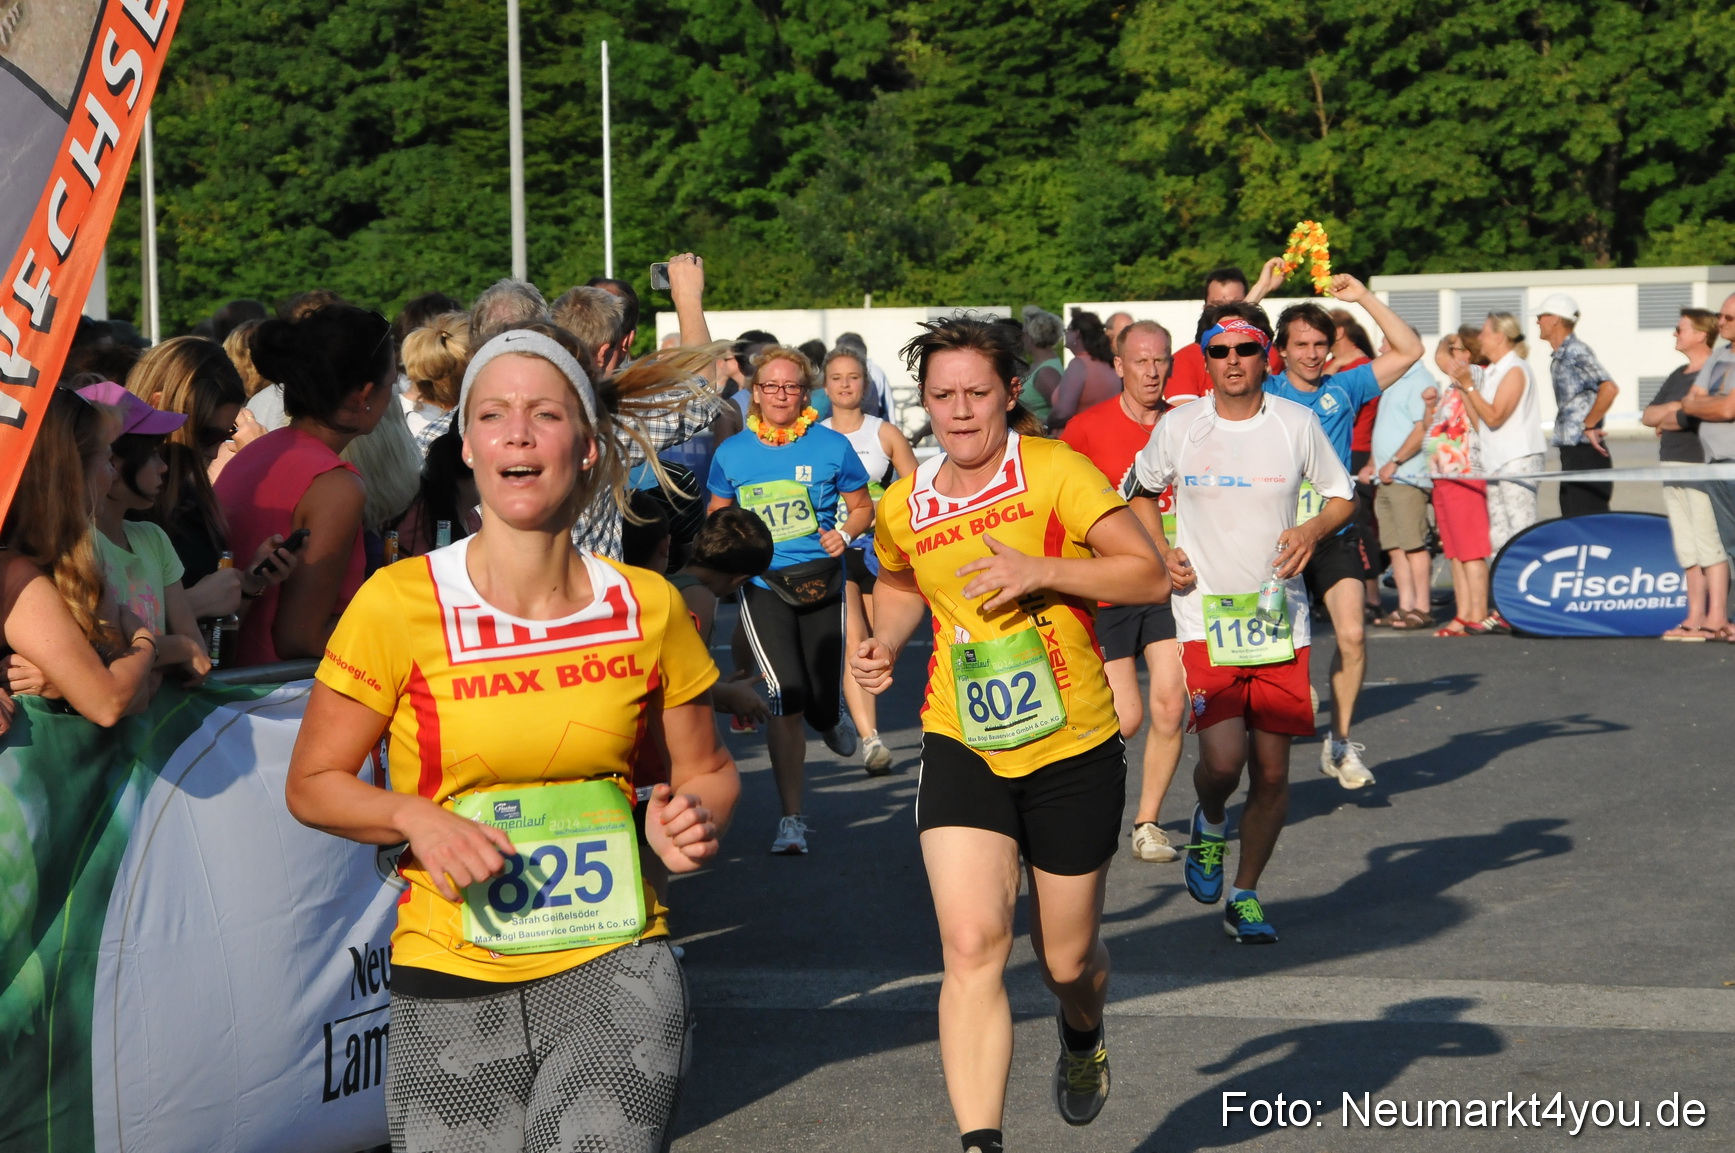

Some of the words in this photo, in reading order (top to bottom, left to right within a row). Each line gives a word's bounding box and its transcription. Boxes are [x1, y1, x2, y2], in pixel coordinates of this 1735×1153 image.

[915, 525, 964, 556] MAX
[970, 502, 1034, 536] BÖGL
[1563, 595, 1688, 613] AUTOMOBILE
[452, 669, 544, 701] MAX
[556, 653, 644, 689] BÖGL
[966, 671, 1043, 724] 802
[989, 732, 1015, 741] Bauservice
[1016, 725, 1034, 735] GmbH
[1050, 715, 1060, 723] KG
[487, 839, 614, 914] 825
[474, 934, 493, 945] Max
[495, 931, 516, 943] Bögl
[518, 926, 567, 939] Bauservice
[569, 922, 596, 934] GmbH
[597, 921, 604, 930] &
[606, 919, 621, 929] Co.
[623, 917, 637, 928] KG
[511, 915, 540, 927] Sarah
[542, 908, 599, 923] Geißelsöder
